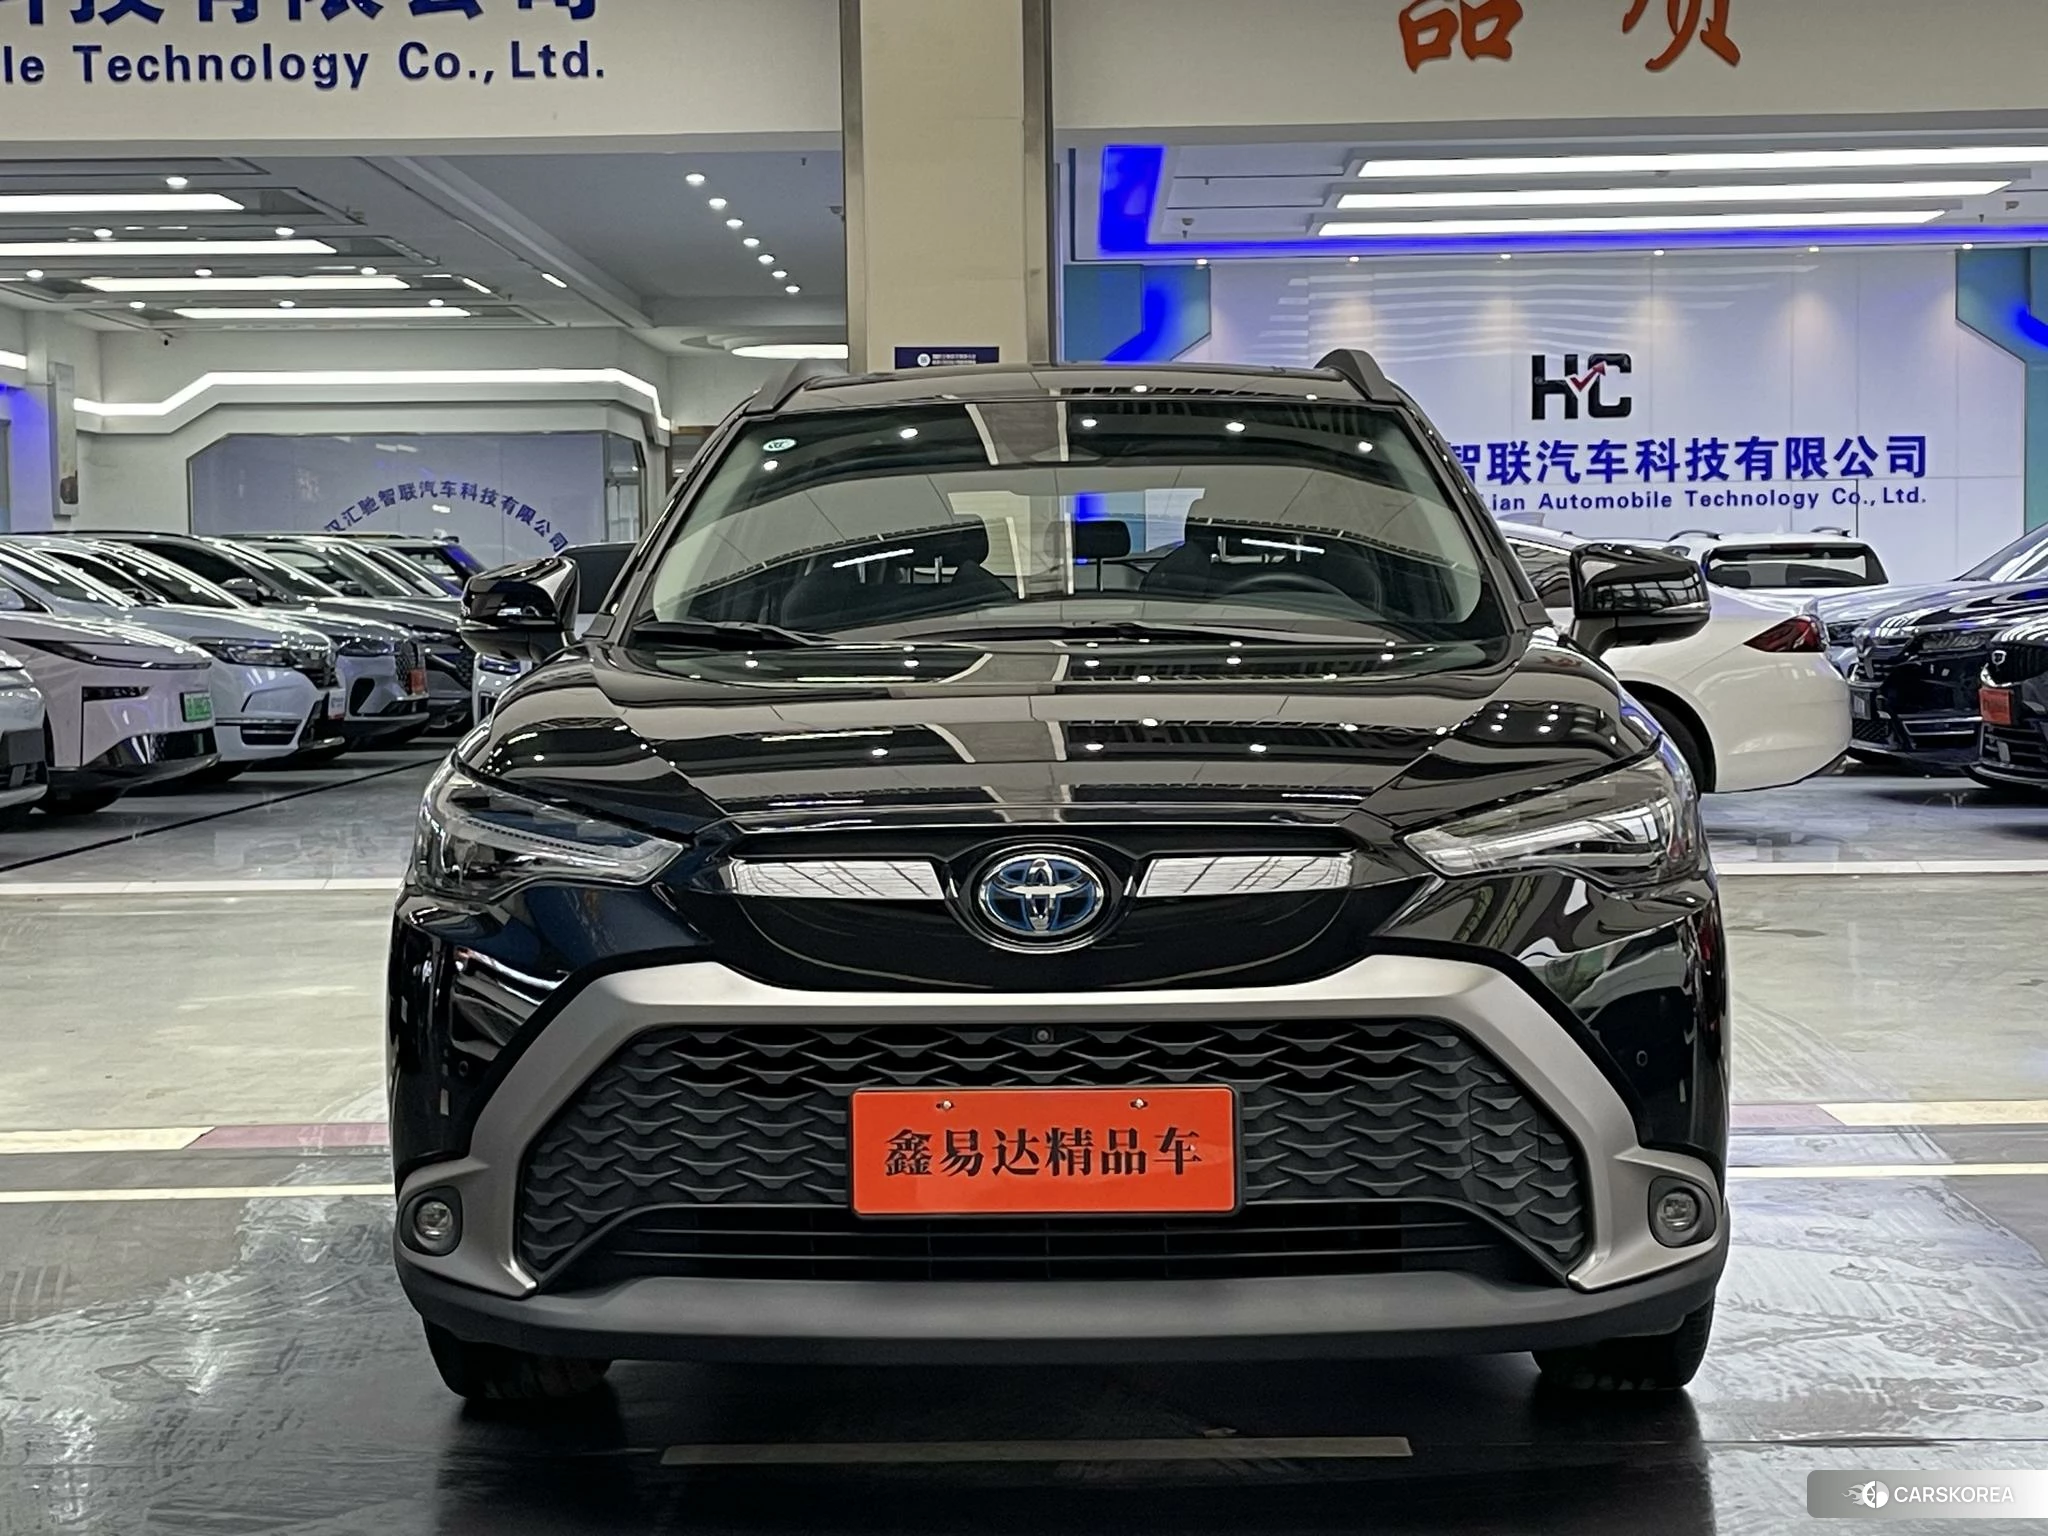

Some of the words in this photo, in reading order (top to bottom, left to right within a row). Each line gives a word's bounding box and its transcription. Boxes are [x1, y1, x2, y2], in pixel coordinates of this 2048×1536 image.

[72, 43, 369, 89] Technology
[1480, 493, 1525, 511] ian
[1538, 490, 1673, 511] Automobile
[1684, 489, 1820, 509] Technology
[884, 1126, 1203, 1178] 鑫易达精品车
